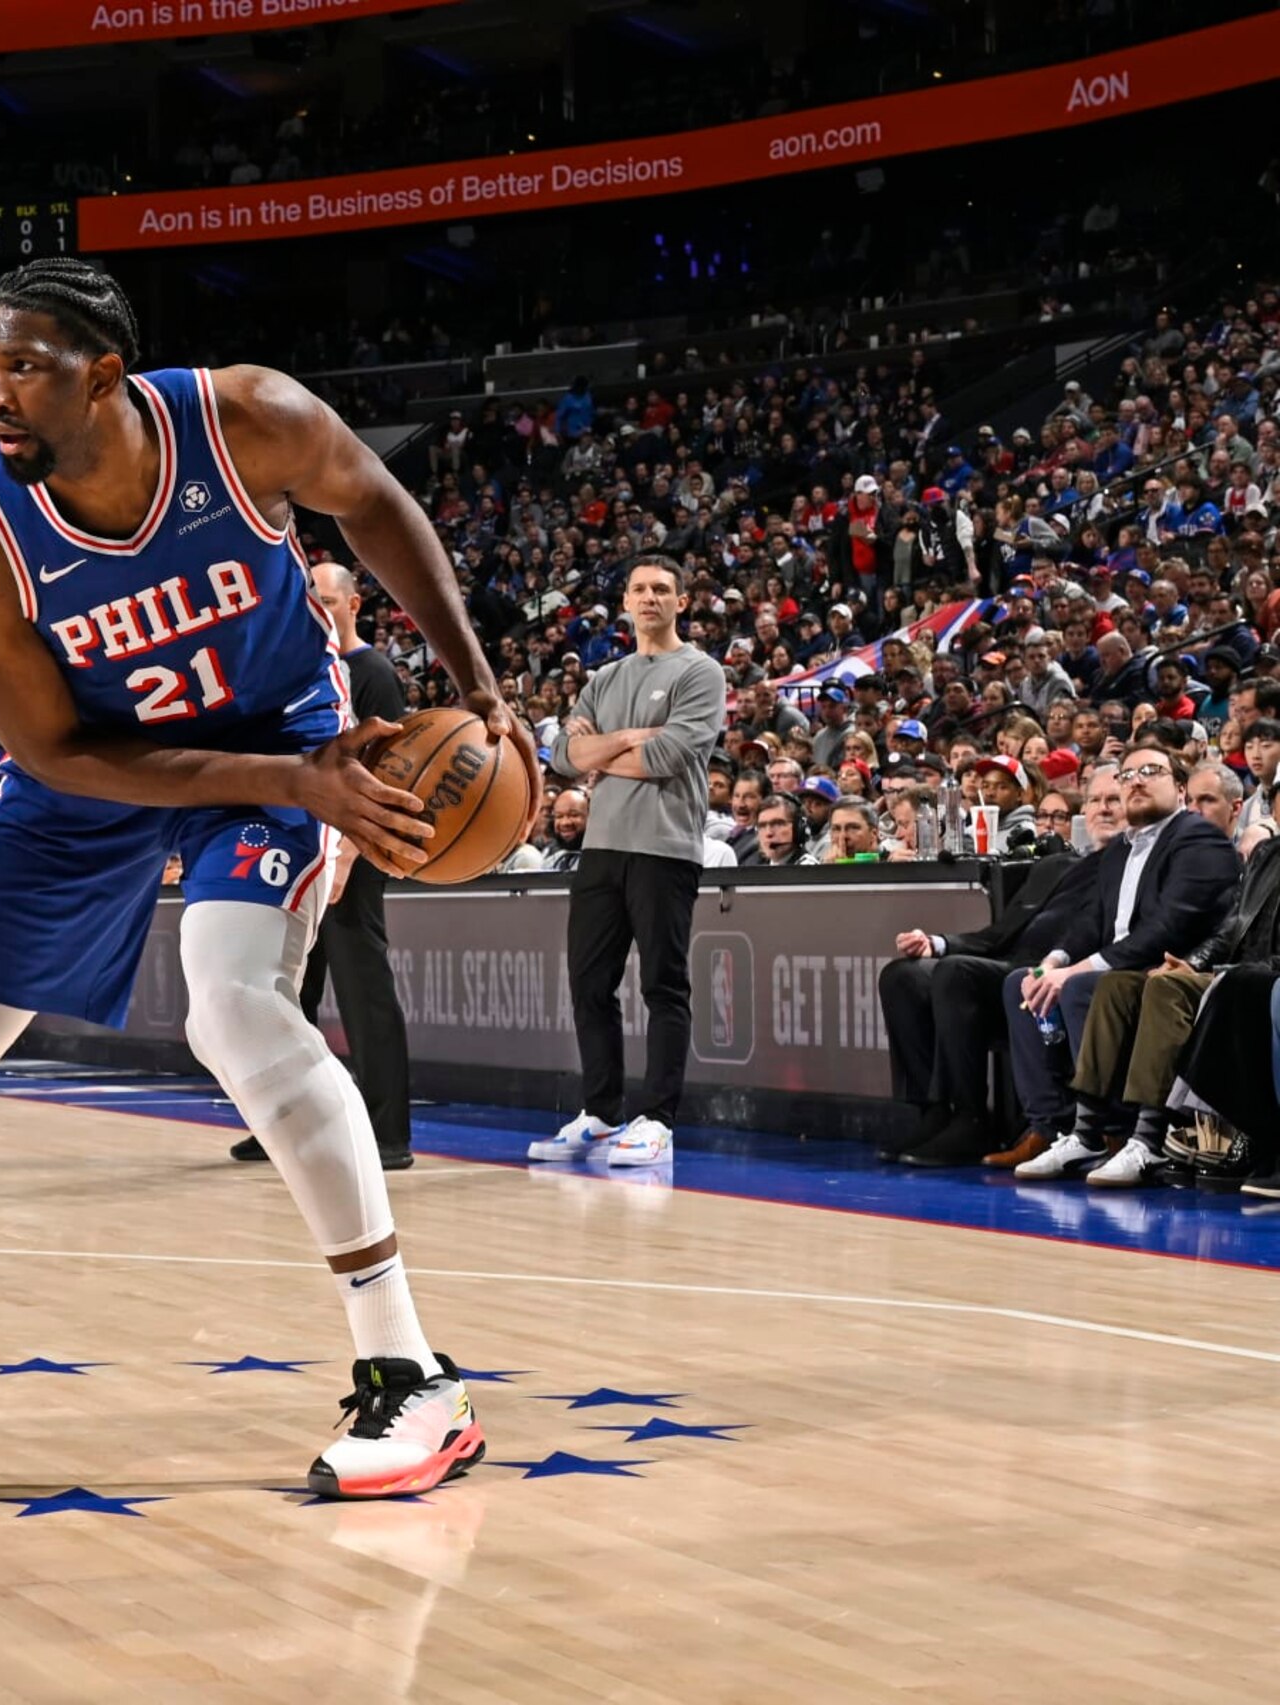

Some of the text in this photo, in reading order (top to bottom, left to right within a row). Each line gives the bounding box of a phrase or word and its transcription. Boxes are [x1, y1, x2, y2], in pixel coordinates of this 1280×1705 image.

[91, 5, 144, 30] Aon
[152, 0, 172, 24] is
[181, 0, 201, 23] in
[1067, 70, 1130, 112] AON
[769, 120, 881, 160] aon.com
[139, 156, 683, 233] Aon is in the Business of Better Decisions
[20, 219, 33, 235] 0
[56, 217, 65, 233] 1
[20, 239, 33, 255] 0
[56, 237, 65, 252] 1
[179, 505, 231, 536] crypto.com
[50, 560, 263, 668] PHILA
[125, 646, 234, 725] 21
[228, 842, 291, 887] 76
[423, 950, 459, 1025] ALL
[462, 949, 551, 1031] SEASON.
[773, 954, 826, 1047] GET
